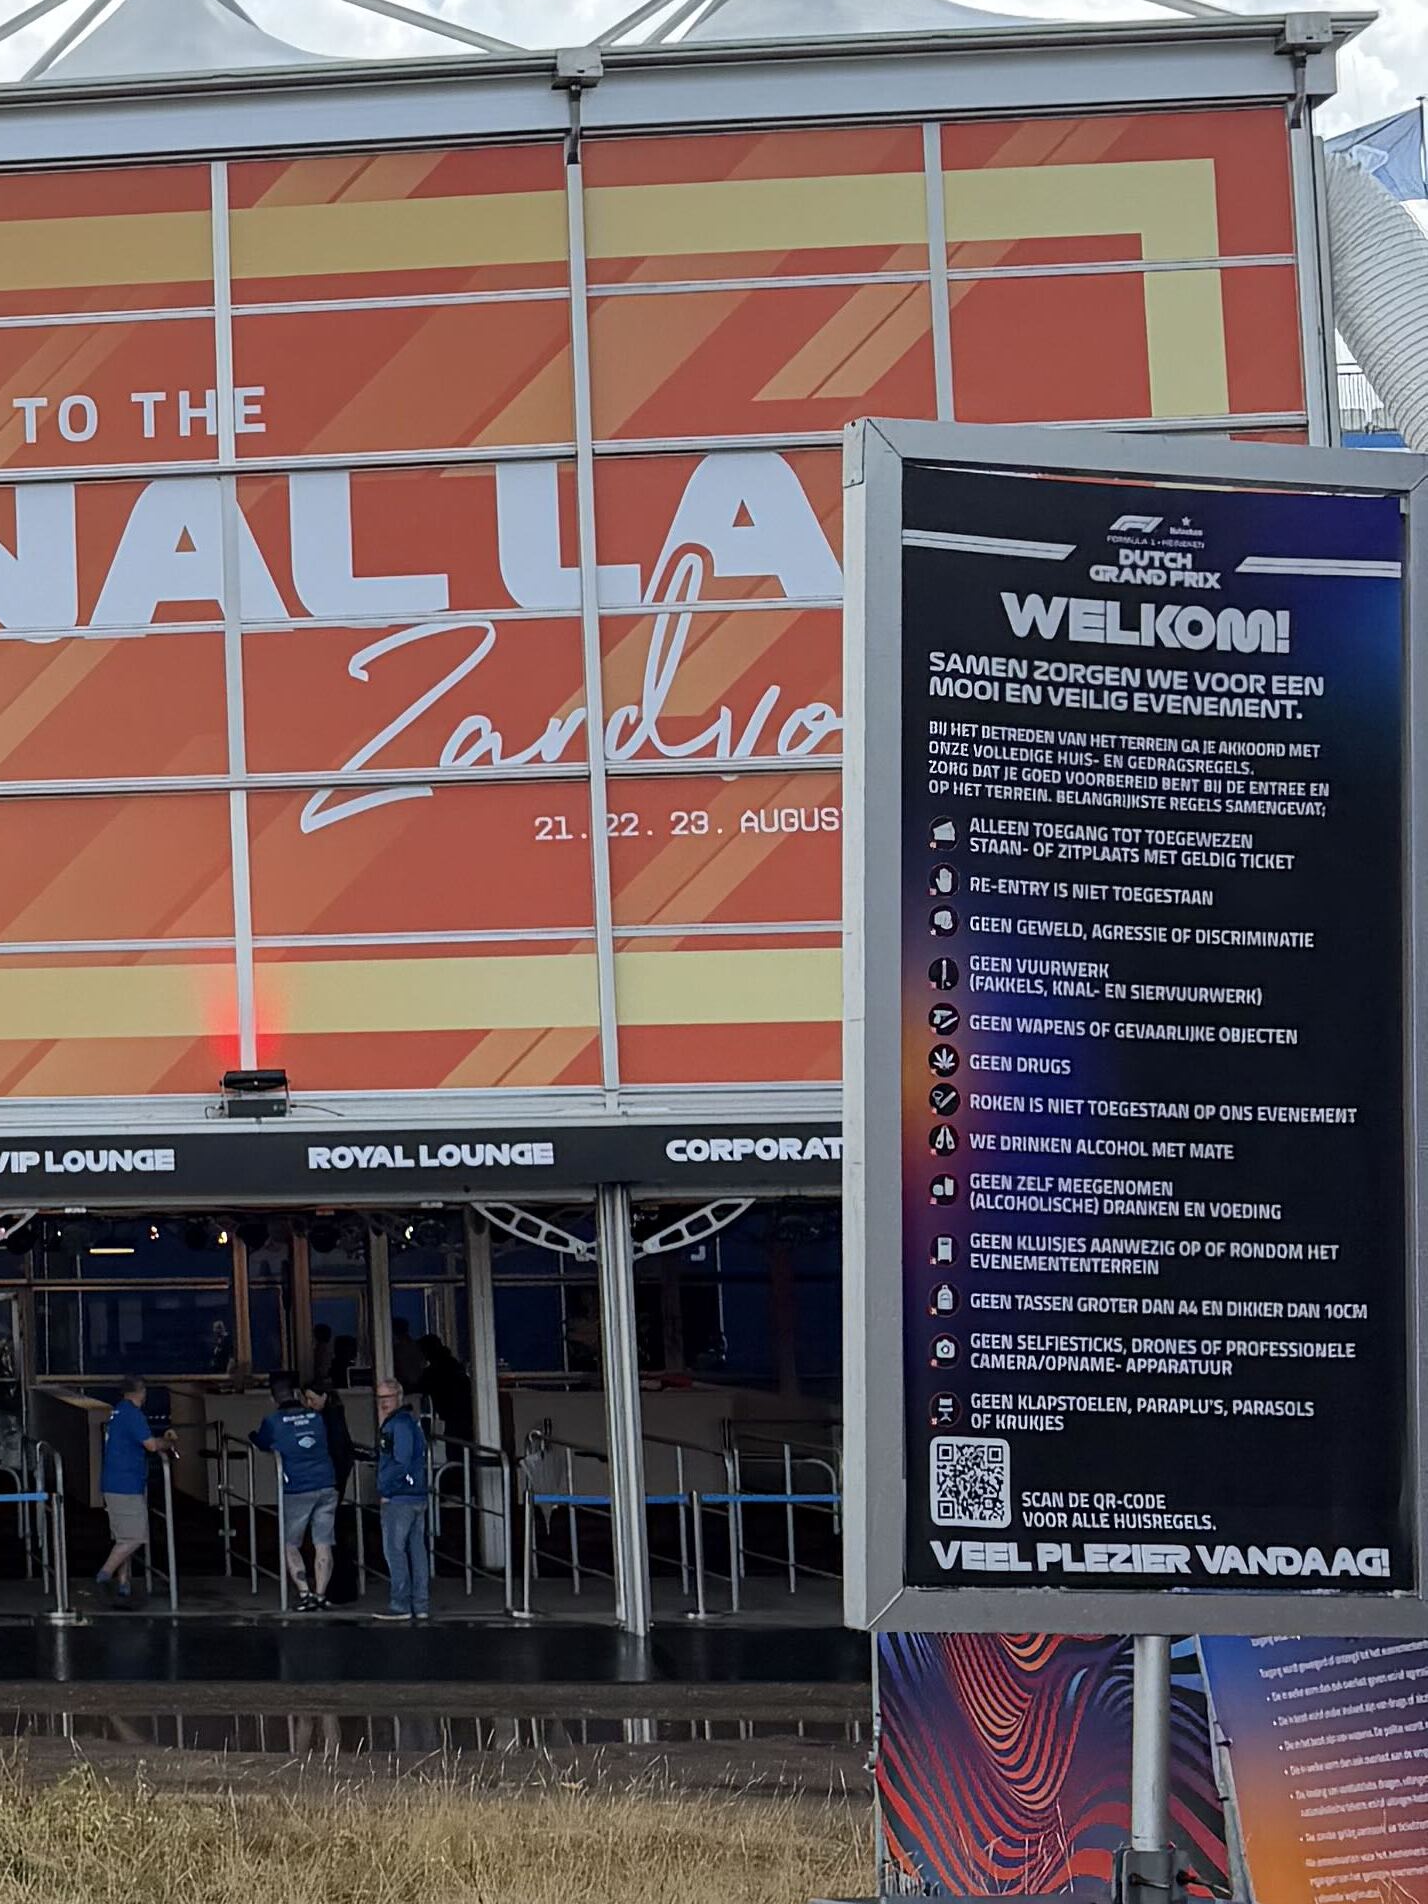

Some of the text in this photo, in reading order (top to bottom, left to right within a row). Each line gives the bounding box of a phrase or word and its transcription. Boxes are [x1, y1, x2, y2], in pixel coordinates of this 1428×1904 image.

[13, 395, 98, 443] TO
[131, 386, 266, 438] THE
[496, 450, 843, 611] LA
[1119, 548, 1192, 570] DUTCH
[1089, 564, 1221, 589] GRAND PRIX
[1000, 592, 1289, 653] WELKOM!
[930, 652, 1323, 696] SAMEN ZORGEN WE VOOR EEN
[930, 677, 1302, 719] MOOI EN VEILIG EVENEMENT.
[534, 807, 843, 840] 21. 22. 23. AUGUS
[970, 818, 1252, 849] ALLEEN TOEGANG TOT TOEGEWEZEN
[970, 837, 1294, 869] STAAN- OF ZITPLAATS MET GELDIG TICKET
[970, 877, 1212, 905] RE-ENTRY IS NIET TOEGESTAAN
[970, 916, 1314, 947] GEEN GEWELD, AGRESSIE OF DISCRIMINATIE
[970, 955, 1108, 978] GEEN VUURWERK
[970, 975, 1262, 1006] (FAKKELS, KNAL- EN SIERVUURWERK)
[970, 1015, 1297, 1044] GEEN WAPENS OF GEVAARLIJKE OBJECTEN
[970, 1055, 1070, 1074] GEEN DRUGS
[970, 1094, 1357, 1123] ROKEN IS NIET TOEGESTAAN OP ONS EVENEMENT
[308, 1142, 554, 1170] ROYAL LOUNGE
[665, 1136, 842, 1162] CORPORAT
[970, 1133, 1234, 1159] WE DRINKEN ALCOHOL MET MATE
[45, 1148, 175, 1174] LOUNGE
[970, 1173, 1172, 1196] GEEN ZELF MEEGENOMEN
[970, 1193, 1281, 1220] (ALCOHOLISCHE) DRANKEN EN VOEDING
[971, 1293, 1367, 1319] GEEN TASSEN GROTER DAN A4 EN DIKKER DAN 10CM
[971, 1333, 1356, 1358] GEEN SELFIESTICKS, DRONES OF PROFESSIONELE
[971, 1353, 1232, 1375] CAMERA/OPNAME- APPARATUUR
[971, 1393, 1314, 1417] GEEN KLAPSTOELEN, PARAPLU'S, PARASOLS
[971, 1413, 1064, 1431] OF KRUKJES
[1022, 1492, 1166, 1511] SCAN DE QR-CODE
[1023, 1512, 1216, 1530] VOOR ALLE HUISREGELS.
[930, 1541, 1390, 1577] VEEL PLEZIER VANDAAG!
